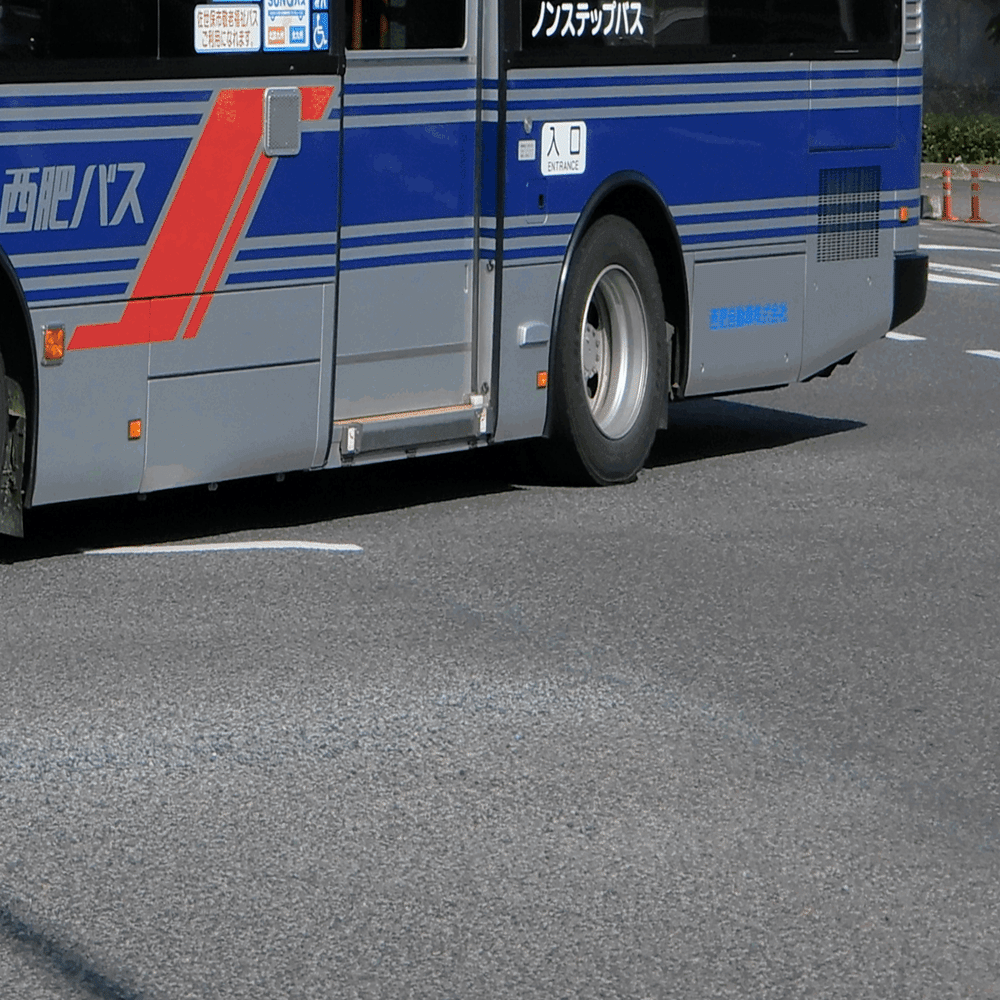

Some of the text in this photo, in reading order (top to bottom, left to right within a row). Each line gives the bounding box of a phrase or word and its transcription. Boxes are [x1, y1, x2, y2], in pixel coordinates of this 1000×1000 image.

[531, 0, 644, 37] ノンステップバス
[547, 126, 581, 157] 入口
[547, 160, 579, 172] ENTRANCE
